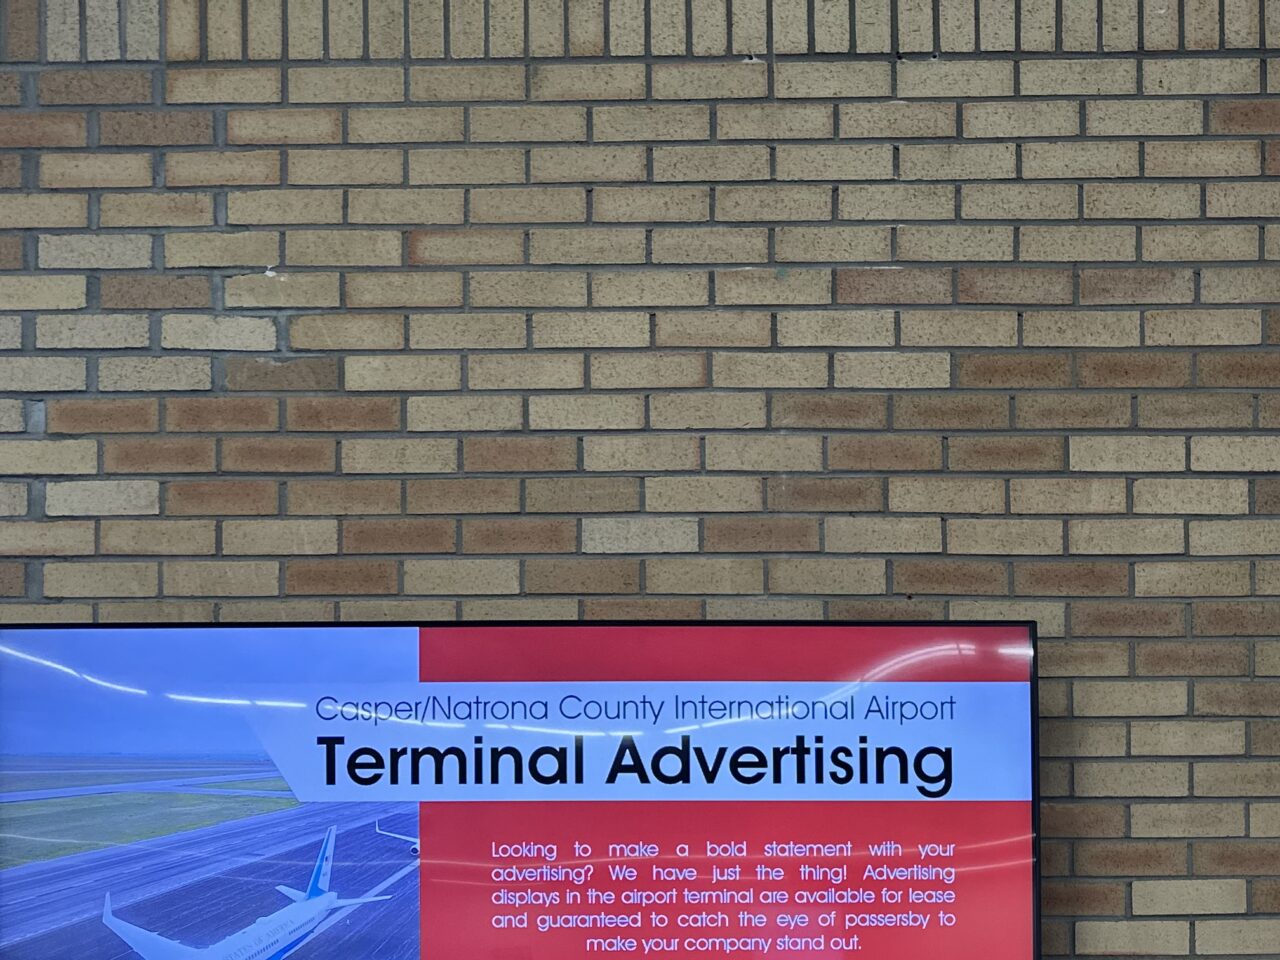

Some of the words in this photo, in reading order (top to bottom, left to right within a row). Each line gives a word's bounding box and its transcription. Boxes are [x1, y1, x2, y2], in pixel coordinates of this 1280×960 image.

[316, 696, 548, 726] Casper/Natrona
[559, 695, 664, 725] County
[676, 695, 854, 720] International
[864, 696, 956, 725] Airport
[317, 736, 583, 785] Terminal
[605, 735, 952, 798] Advertising
[492, 842, 556, 860] Looking
[575, 842, 592, 857] to
[608, 841, 659, 860] make
[676, 844, 688, 857] a
[707, 841, 746, 857] bold
[762, 841, 852, 856] statement
[868, 841, 902, 856] with
[918, 844, 955, 859] your
[492, 865, 593, 884] advertising?
[609, 865, 637, 880] We
[653, 865, 697, 880] have
[712, 865, 741, 883] just
[756, 865, 784, 880] the
[800, 865, 846, 884] thing!
[863, 865, 955, 883] Advertising
[492, 889, 559, 907] displays
[567, 889, 582, 904] in
[587, 889, 615, 904] the
[621, 888, 677, 906] airport
[683, 888, 753, 903] terminal
[760, 891, 788, 903] are
[795, 888, 875, 903] available
[881, 888, 903, 903] for
[909, 888, 955, 903] lease
[492, 912, 527, 928] and
[537, 912, 641, 931] guaranteed
[650, 912, 668, 927] to
[678, 912, 728, 927] catch
[738, 912, 767, 926] the
[777, 914, 808, 929] eye
[818, 911, 836, 926] of
[846, 911, 930, 929] passersby
[938, 911, 956, 926] to
[587, 936, 637, 951] make
[642, 939, 679, 954] your
[684, 939, 772, 954] company
[777, 935, 824, 950] stand
[830, 935, 861, 950] out.
